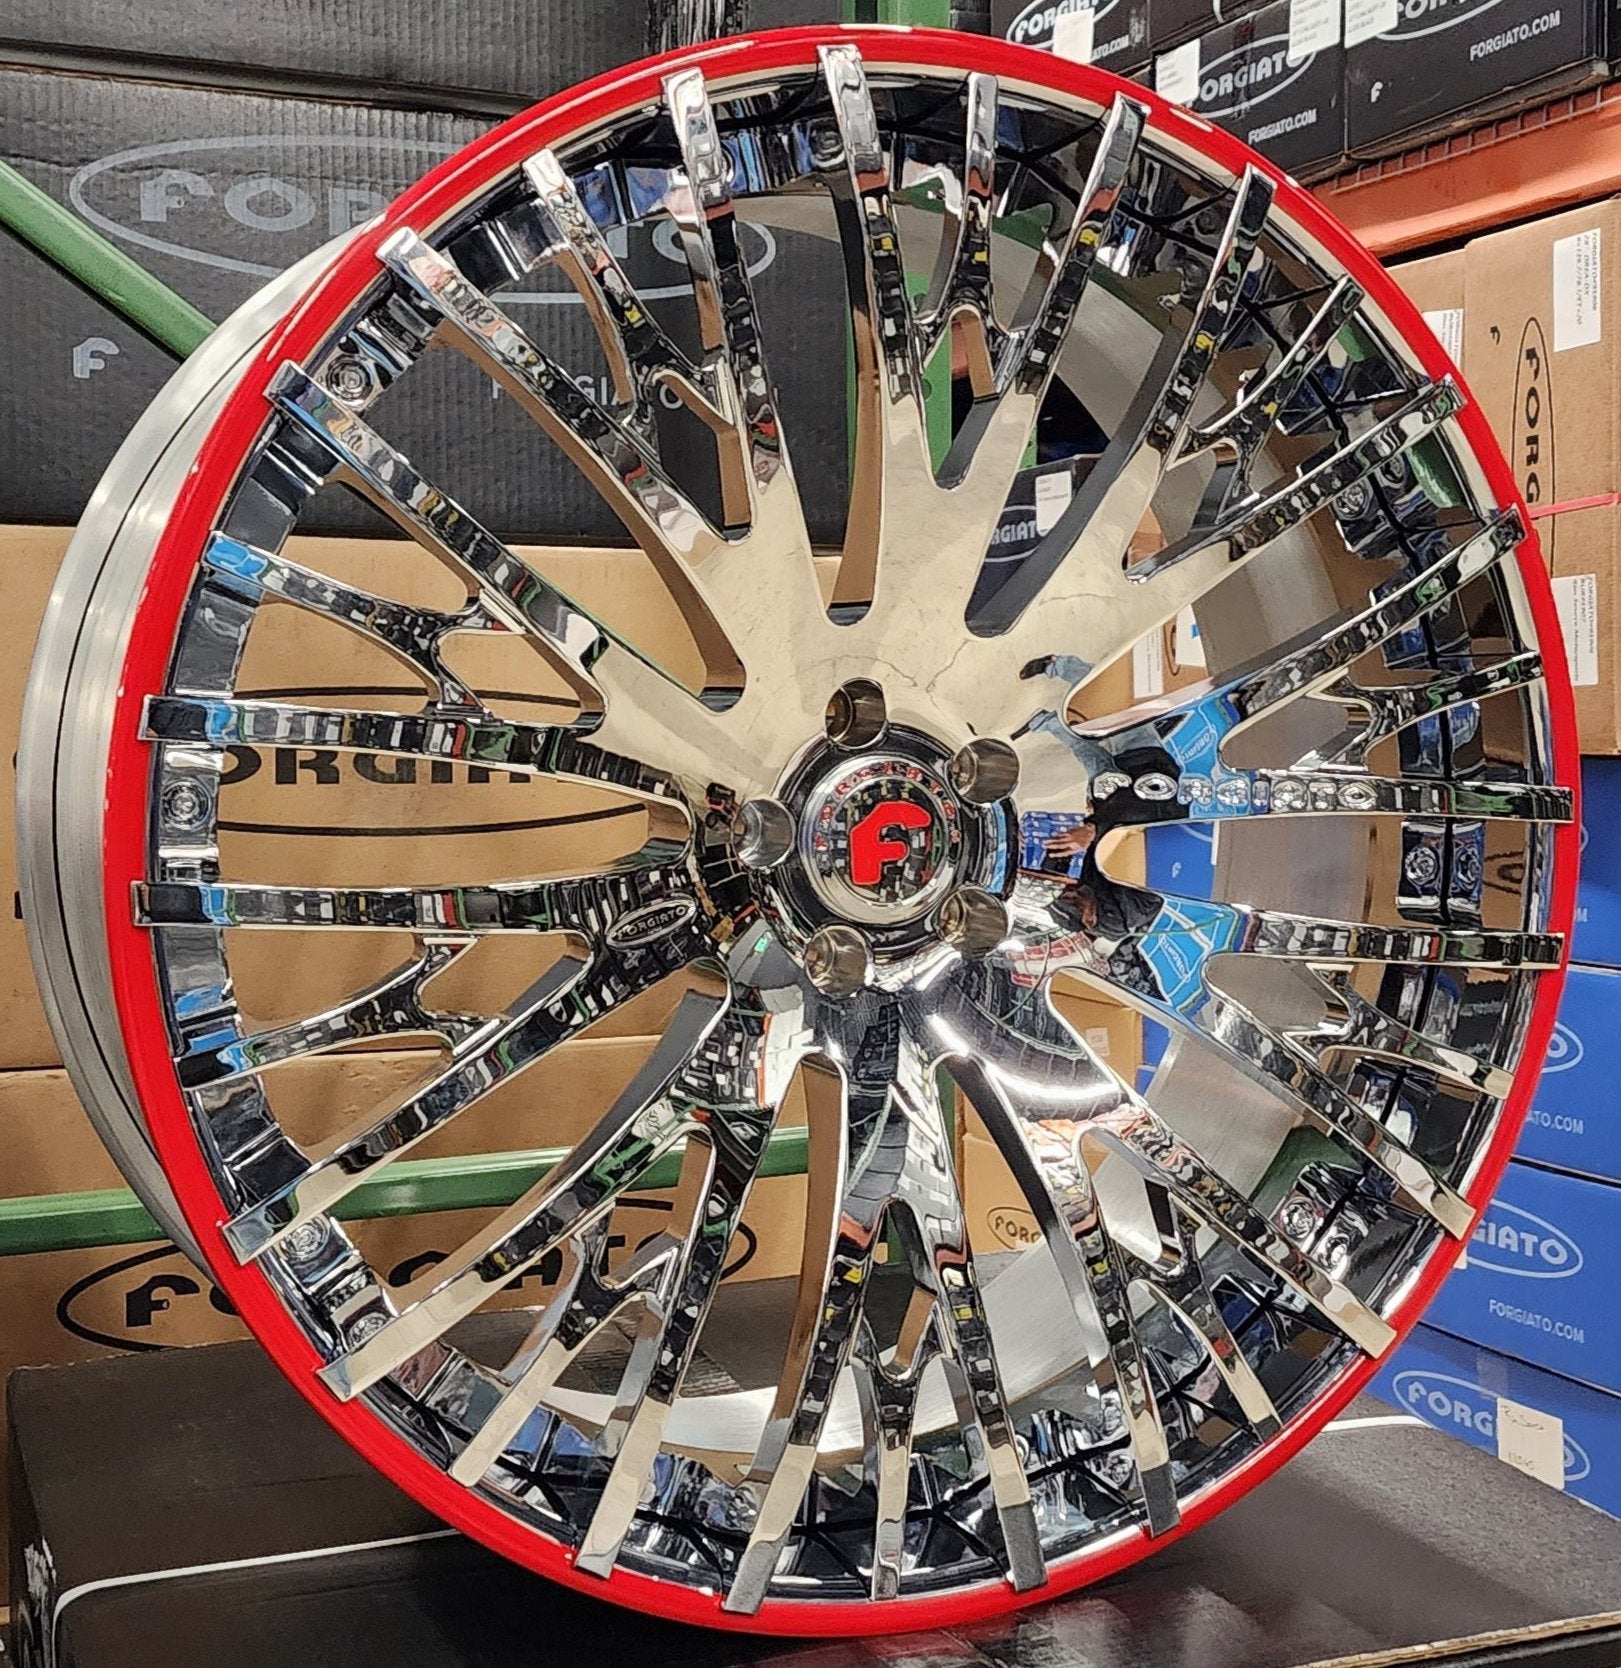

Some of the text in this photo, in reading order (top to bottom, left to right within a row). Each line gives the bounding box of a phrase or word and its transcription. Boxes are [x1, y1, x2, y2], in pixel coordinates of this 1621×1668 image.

[1092, 34, 1130, 61] ATO.COM
[1469, 9, 1561, 62] FORGIATO.COM
[1187, 50, 1304, 108] ORGIAT
[1248, 108, 1317, 145] FORGIATO.COM
[73, 337, 120, 379] F
[1525, 347, 1541, 504] FORG
[991, 520, 1036, 546] RGIAT
[850, 800, 933, 886] F
[617, 906, 686, 941] FORGIATO
[1526, 1110, 1584, 1135] ATO.COM
[1471, 1219, 1568, 1266] GIATO
[1488, 1299, 1585, 1344] FORGIATO.COM
